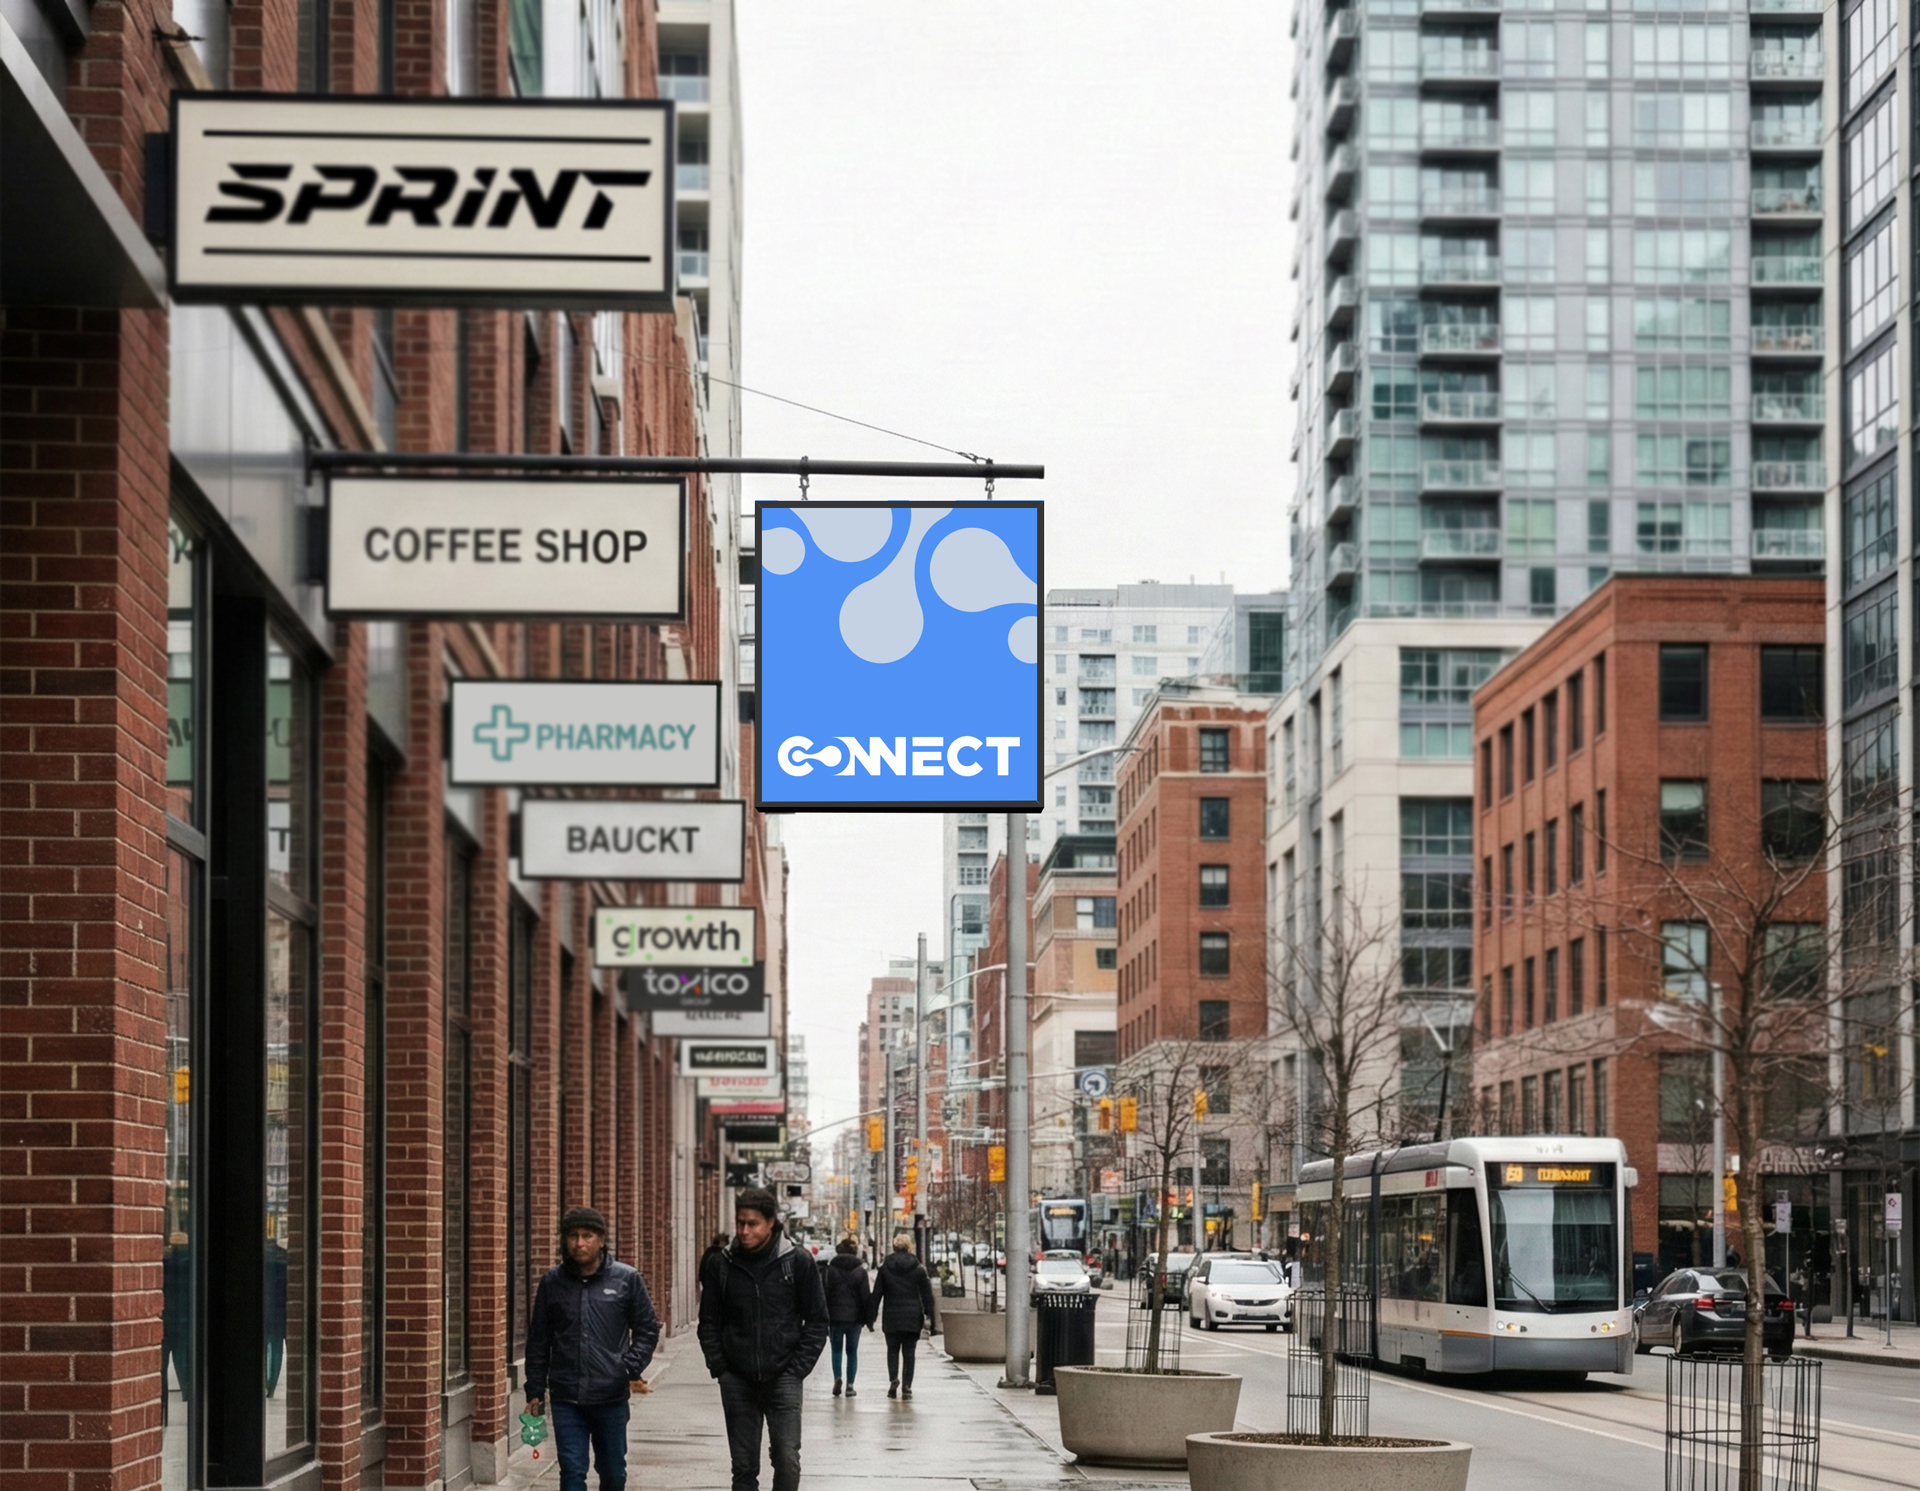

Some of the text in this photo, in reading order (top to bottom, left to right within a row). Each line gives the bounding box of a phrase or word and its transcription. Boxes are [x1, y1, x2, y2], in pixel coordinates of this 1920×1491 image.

[364, 526, 648, 565] COFFEE SHOP
[536, 723, 697, 751] PHARMACY
[777, 735, 1021, 777] CONNECT
[566, 825, 700, 854] BAUCKT
[612, 920, 741, 957] growth
[642, 968, 750, 996] toxico
